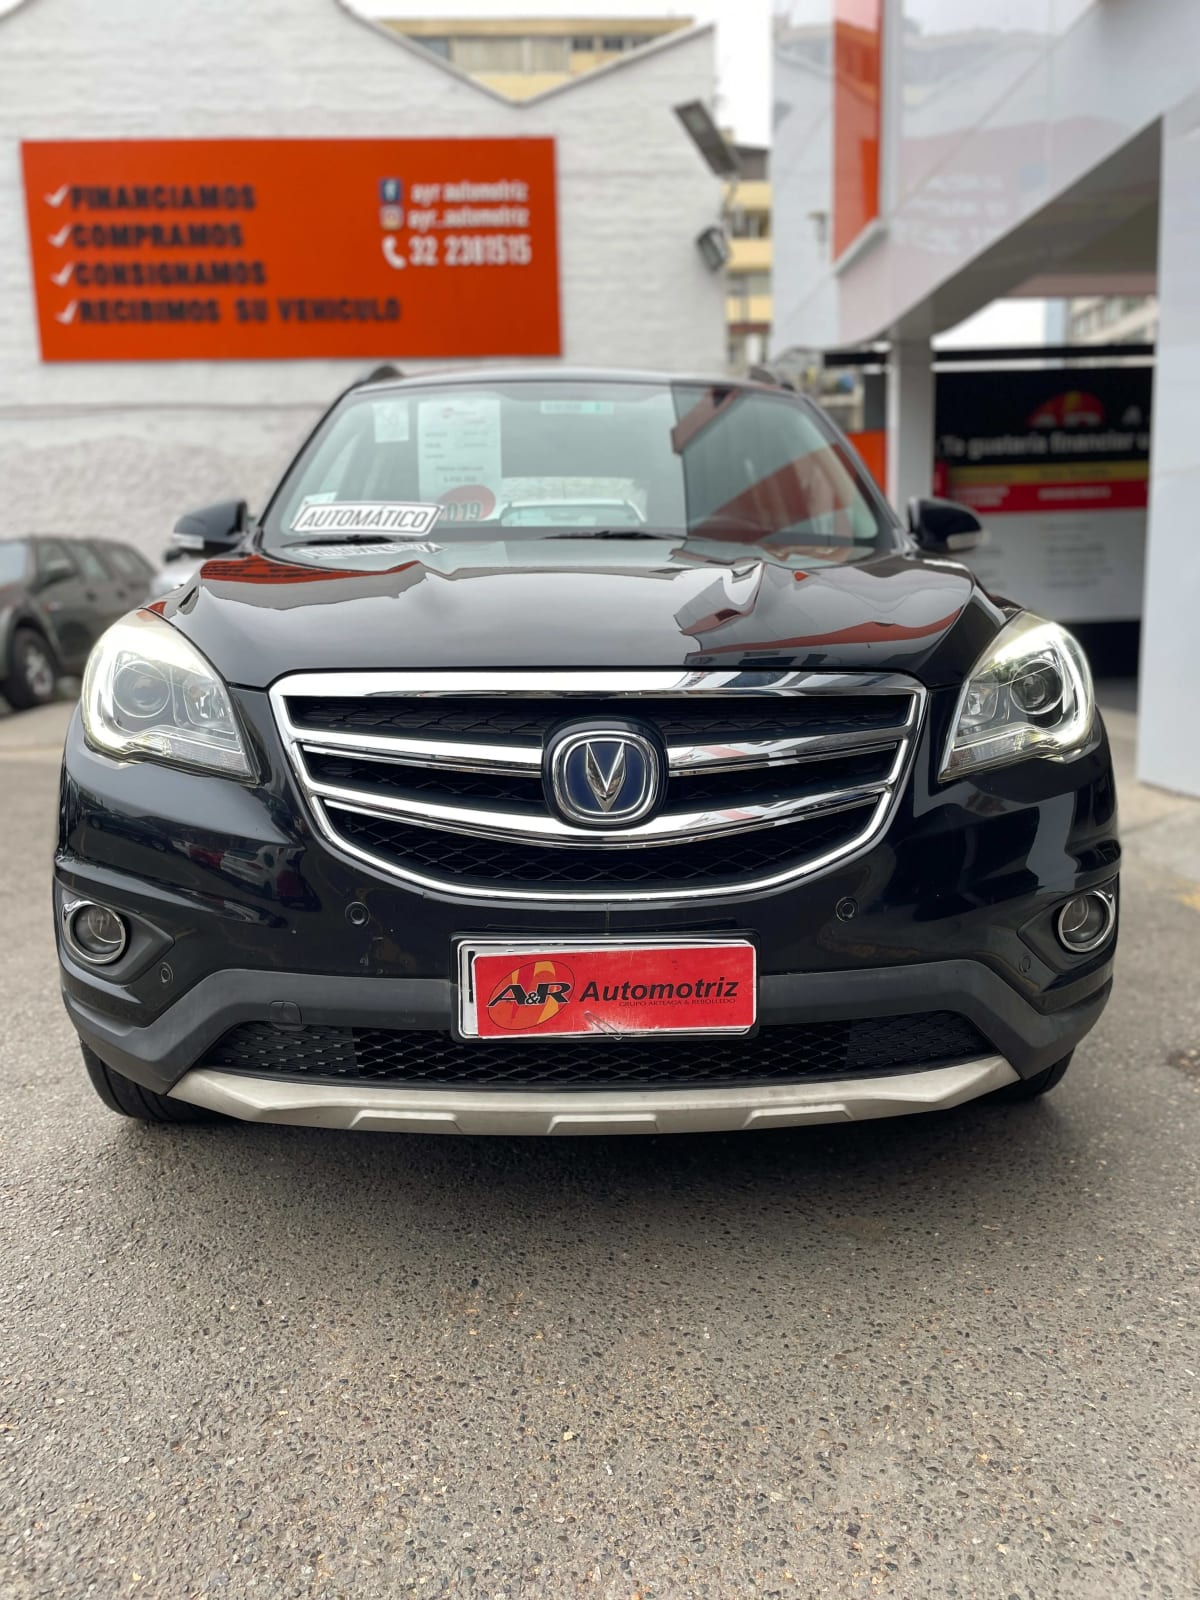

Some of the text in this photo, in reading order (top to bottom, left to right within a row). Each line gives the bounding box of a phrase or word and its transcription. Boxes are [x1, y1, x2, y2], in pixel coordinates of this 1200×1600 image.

[71, 185, 255, 210] FINANCIAMOS
[443, 180, 529, 203] automotriz
[73, 223, 243, 247] COMPRAMOS
[75, 262, 266, 286] CONSIGNAMOS
[80, 298, 402, 324] RECIBIMOS SU VEHICULO
[300, 506, 429, 528] AUTOMÁTICO
[441, 502, 481, 520] 019
[487, 977, 739, 1008] A&R Automotriz
